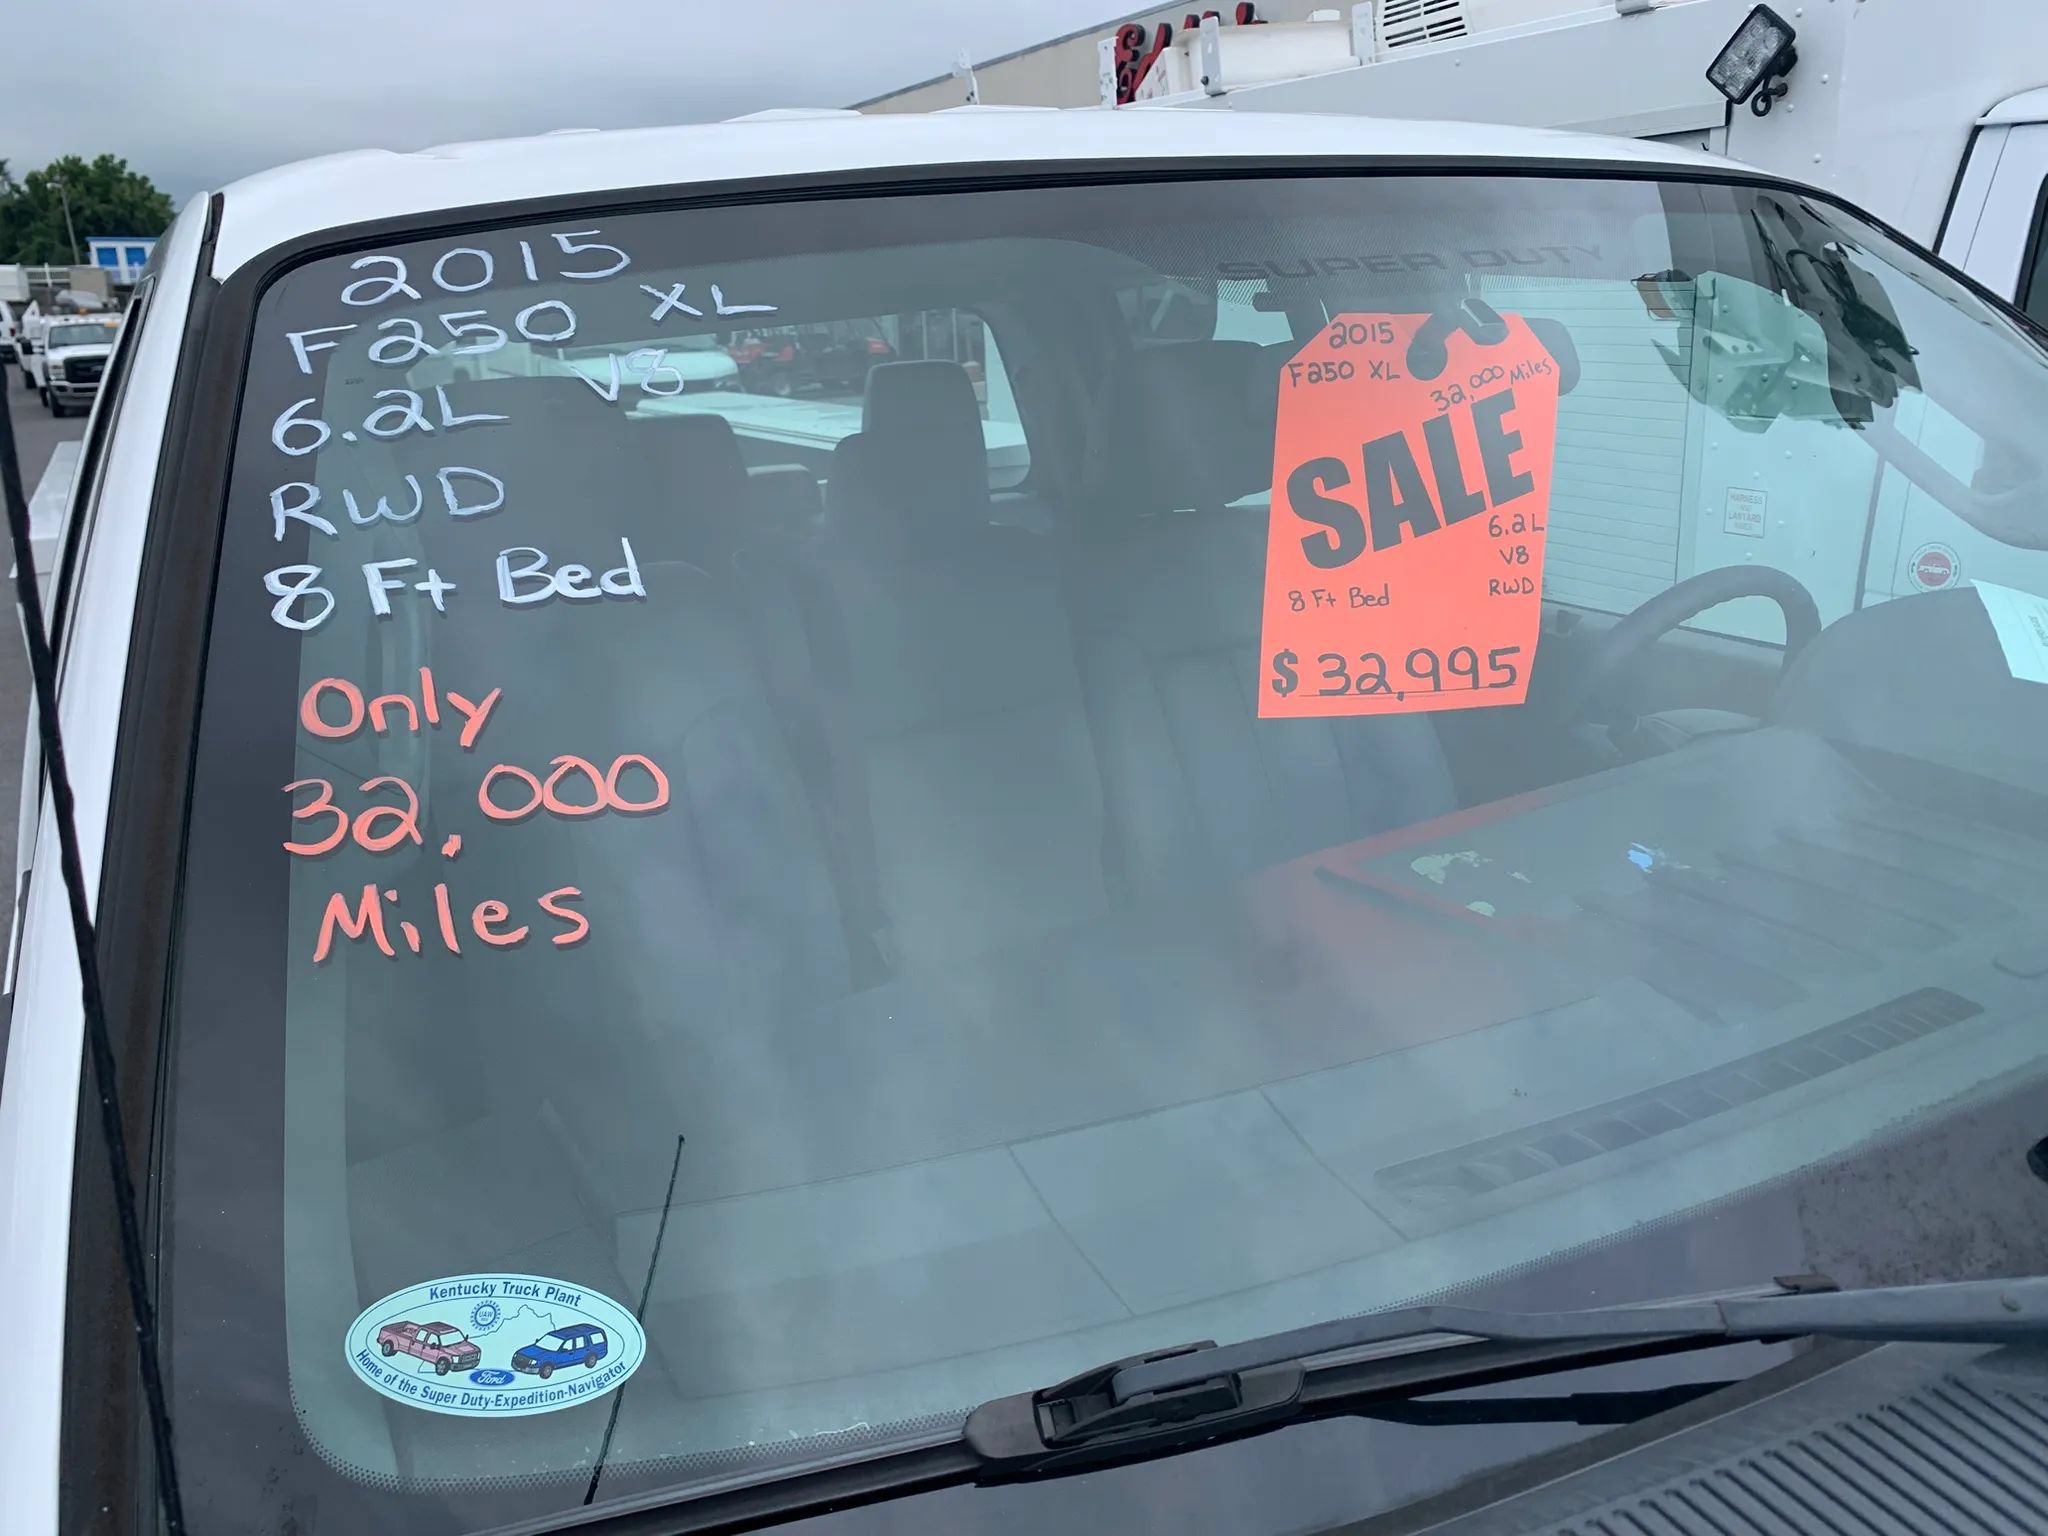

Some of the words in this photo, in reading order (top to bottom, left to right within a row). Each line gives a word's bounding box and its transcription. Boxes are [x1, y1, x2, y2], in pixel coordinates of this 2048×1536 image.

[341, 230, 631, 306] 2015
[1215, 252, 1446, 279] SUPER
[1461, 245, 1604, 268] DUTY
[286, 300, 577, 374] F250
[640, 282, 778, 321] XL
[1329, 321, 1395, 349] 2015
[1288, 360, 1354, 387] F250
[1368, 360, 1400, 381] XL
[1430, 366, 1505, 412] 32,000
[1509, 358, 1552, 384] Miles
[271, 388, 510, 456] 6.2L
[572, 348, 685, 402] V8
[270, 466, 504, 542] RWD
[1286, 387, 1536, 570] SALE
[1488, 513, 1545, 538] 6.2L
[1498, 545, 1529, 565] V8
[263, 564, 336, 630] 8
[361, 557, 457, 615] Ft
[496, 537, 646, 603] Bed
[1287, 590, 1306, 611] 8
[1311, 589, 1337, 608] Ft
[1349, 583, 1391, 608] Bed
[1488, 576, 1535, 597] RWD
[300, 666, 502, 747] Only
[281, 753, 670, 857] 32,000
[313, 883, 590, 963] Miles
[429, 1281, 496, 1301] Kentucky
[502, 1281, 540, 1298] Truck
[545, 1286, 582, 1308] Plant
[478, 1311, 494, 1319] UAW
[356, 1349, 382, 1378] Home
[383, 1372, 398, 1387] of
[398, 1378, 418, 1395] the
[420, 1386, 458, 1406] Super
[477, 1370, 507, 1385] Ford
